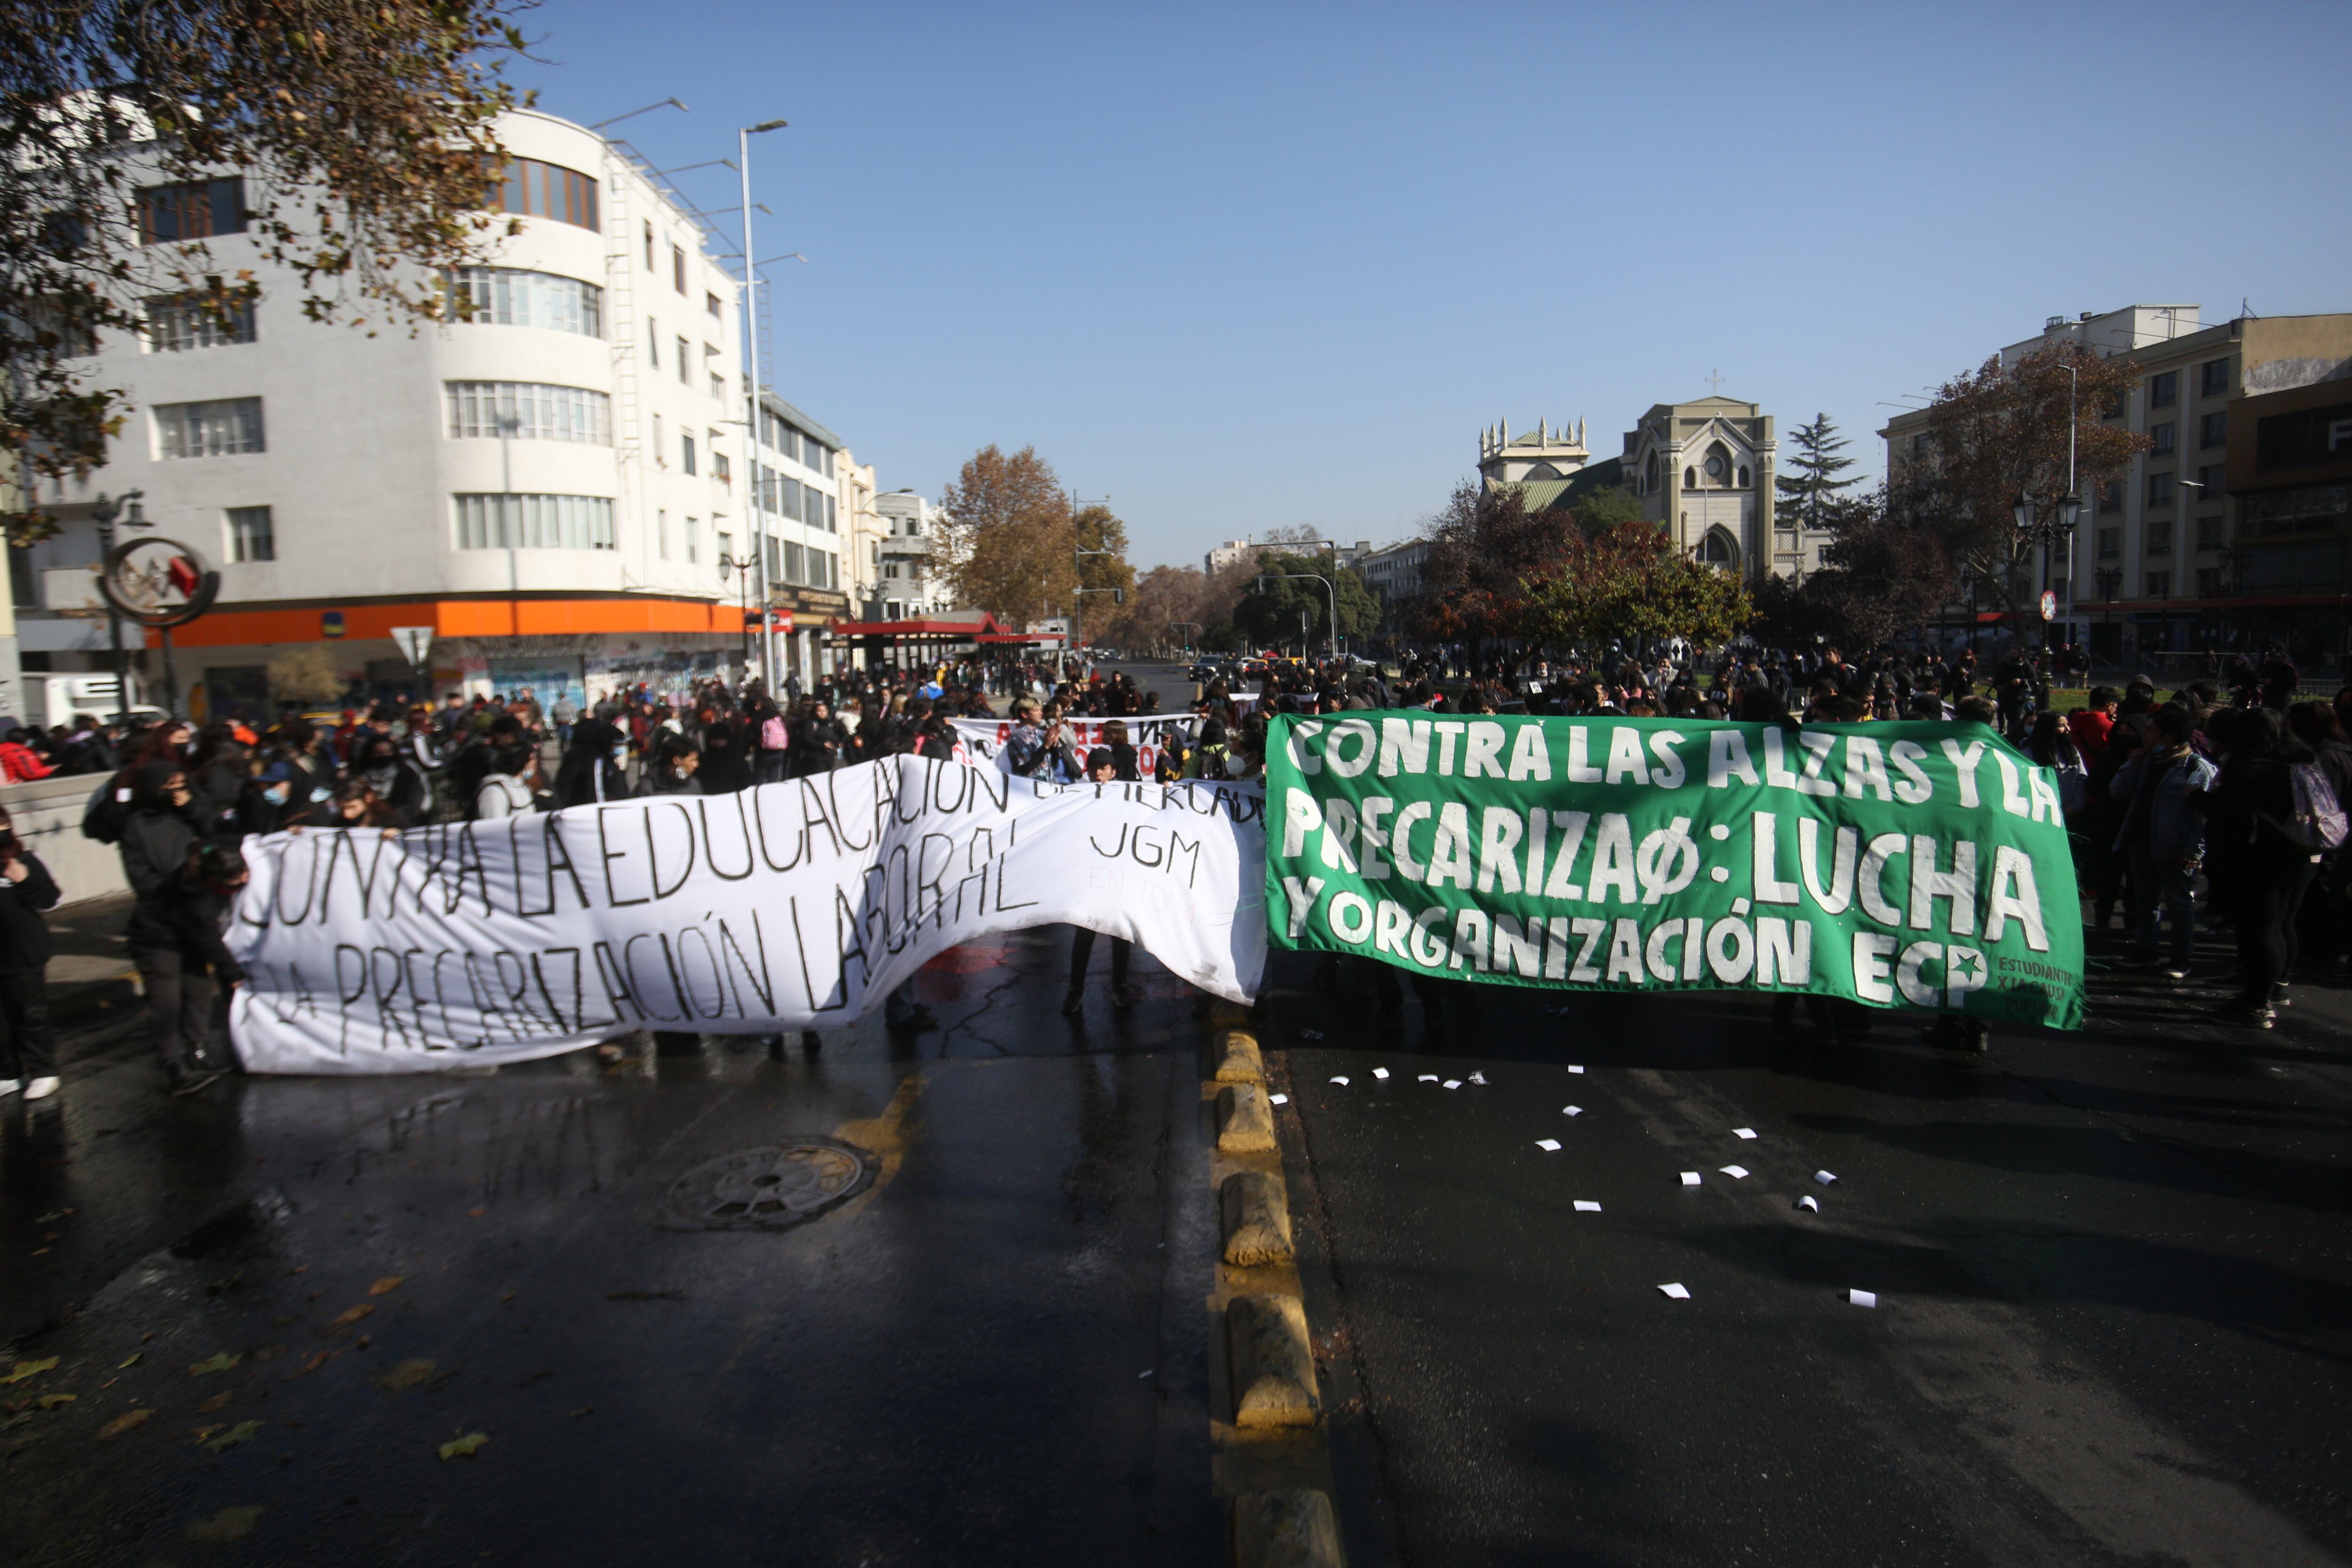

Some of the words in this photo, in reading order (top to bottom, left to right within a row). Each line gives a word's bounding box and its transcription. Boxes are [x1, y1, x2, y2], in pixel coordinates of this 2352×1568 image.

[1567, 725, 1687, 789] LAS
[1708, 726, 1932, 804] ALZAS
[1940, 738, 1986, 808] Y
[1994, 749, 2061, 828] LA
[509, 812, 590, 915] LA
[1089, 822, 1200, 890] JGM
[1750, 811, 2048, 952] LUCHA
[1281, 876, 1325, 939] Y
[1327, 898, 1813, 987] ORGANIZACIÓN
[1853, 931, 1988, 1010] ECP
[1998, 975, 2007, 990] X
